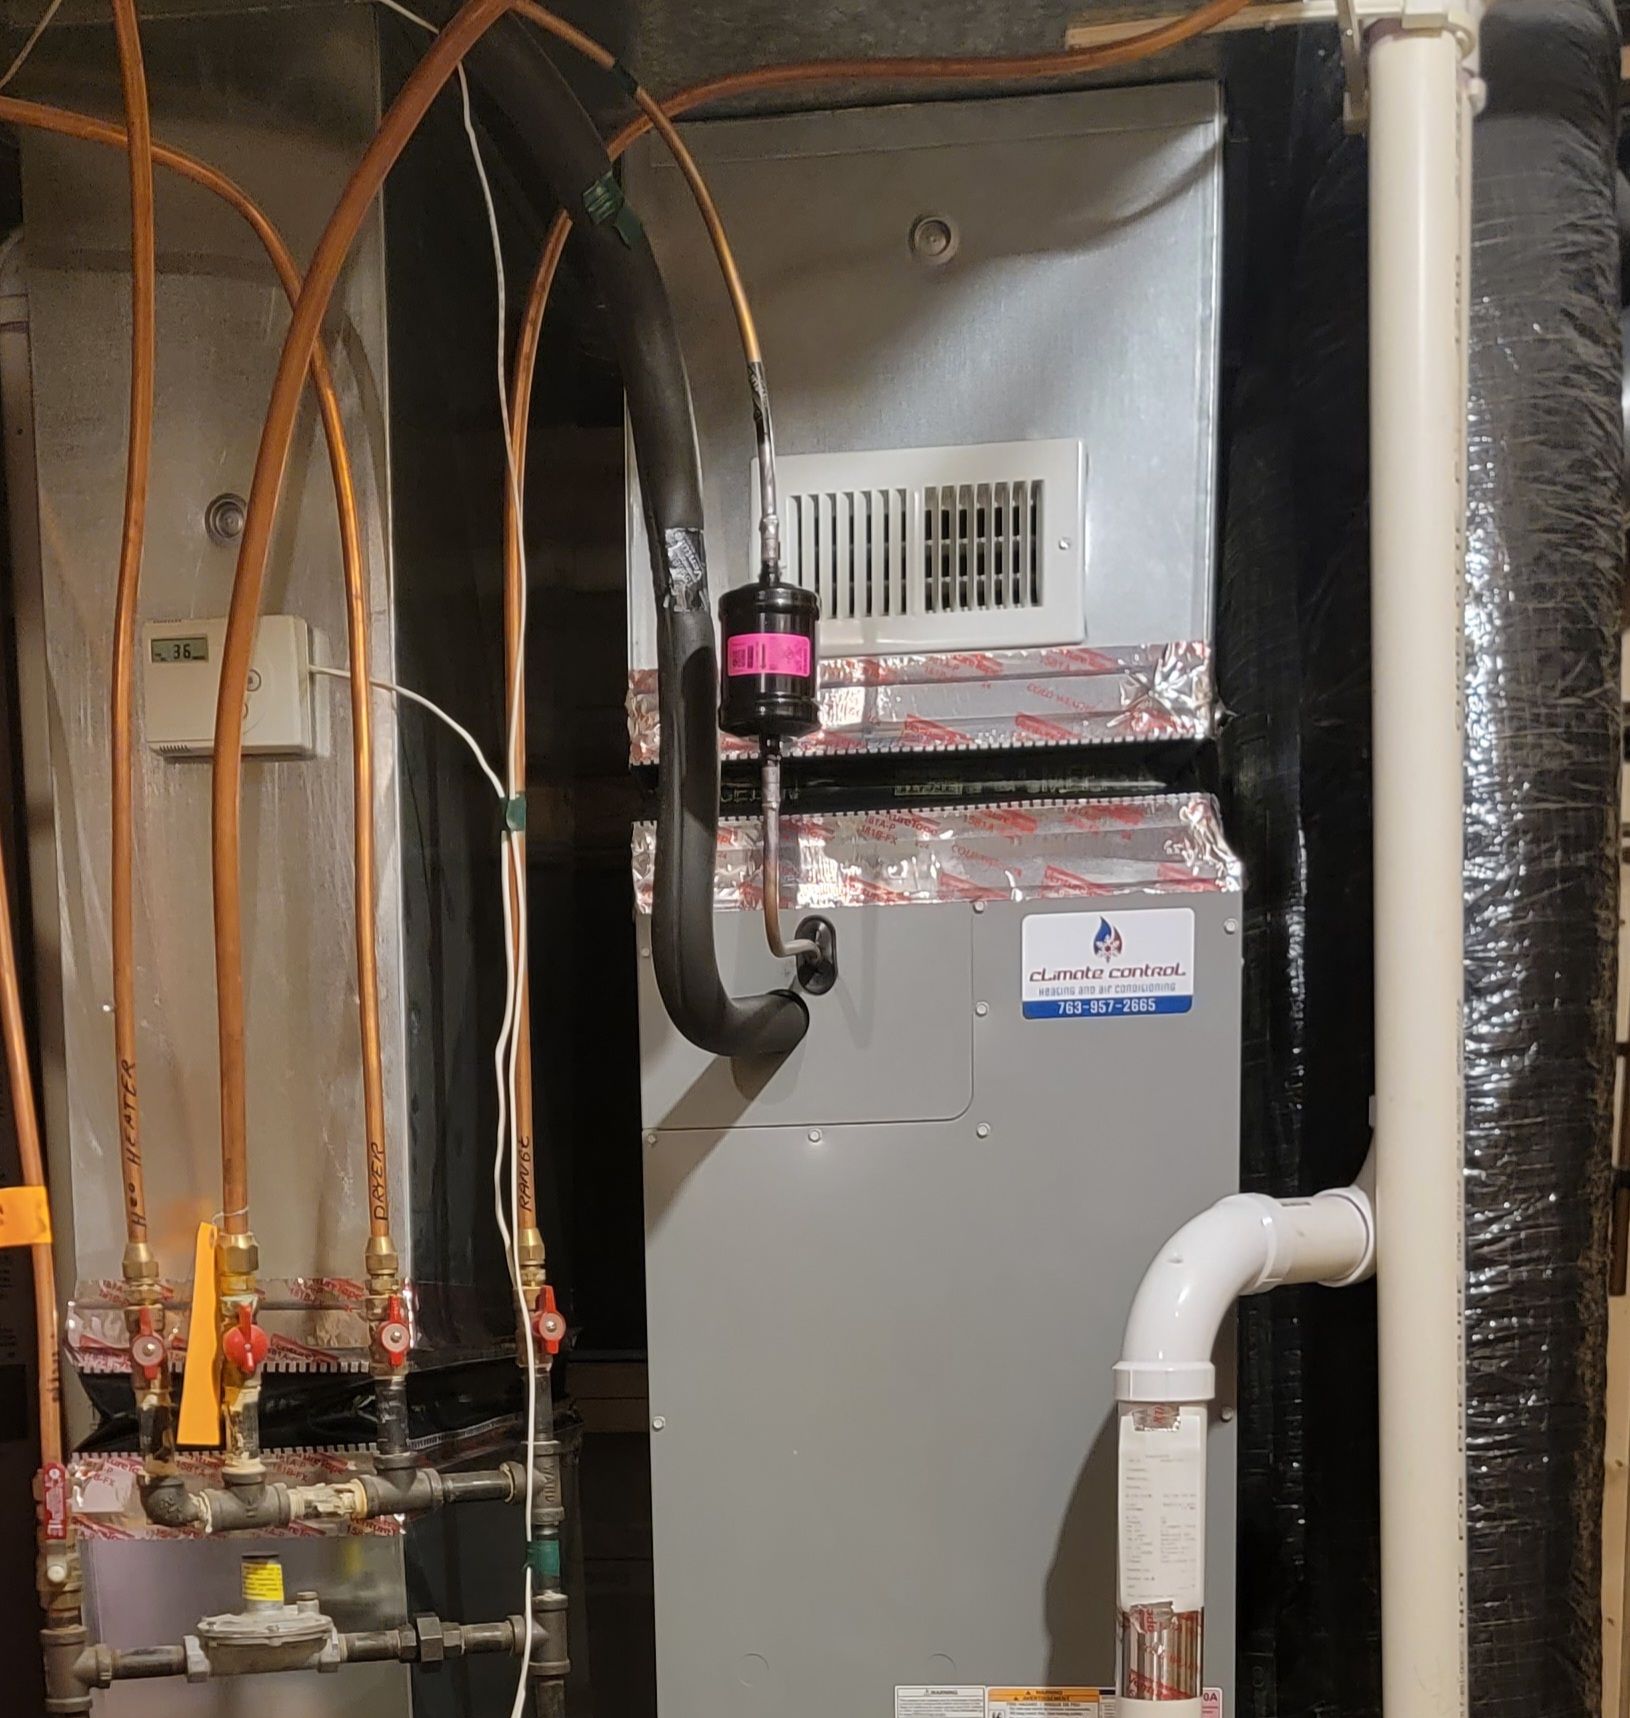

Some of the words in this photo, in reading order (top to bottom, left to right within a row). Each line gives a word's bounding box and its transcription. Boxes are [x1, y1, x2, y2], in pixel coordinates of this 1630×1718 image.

[173, 643, 191, 660] 36
[1057, 998, 1156, 1015] 763-957-2665
[120, 1059, 141, 1167] HEATER
[371, 1142, 389, 1221] DRYER
[518, 1135, 533, 1212] RANGE
